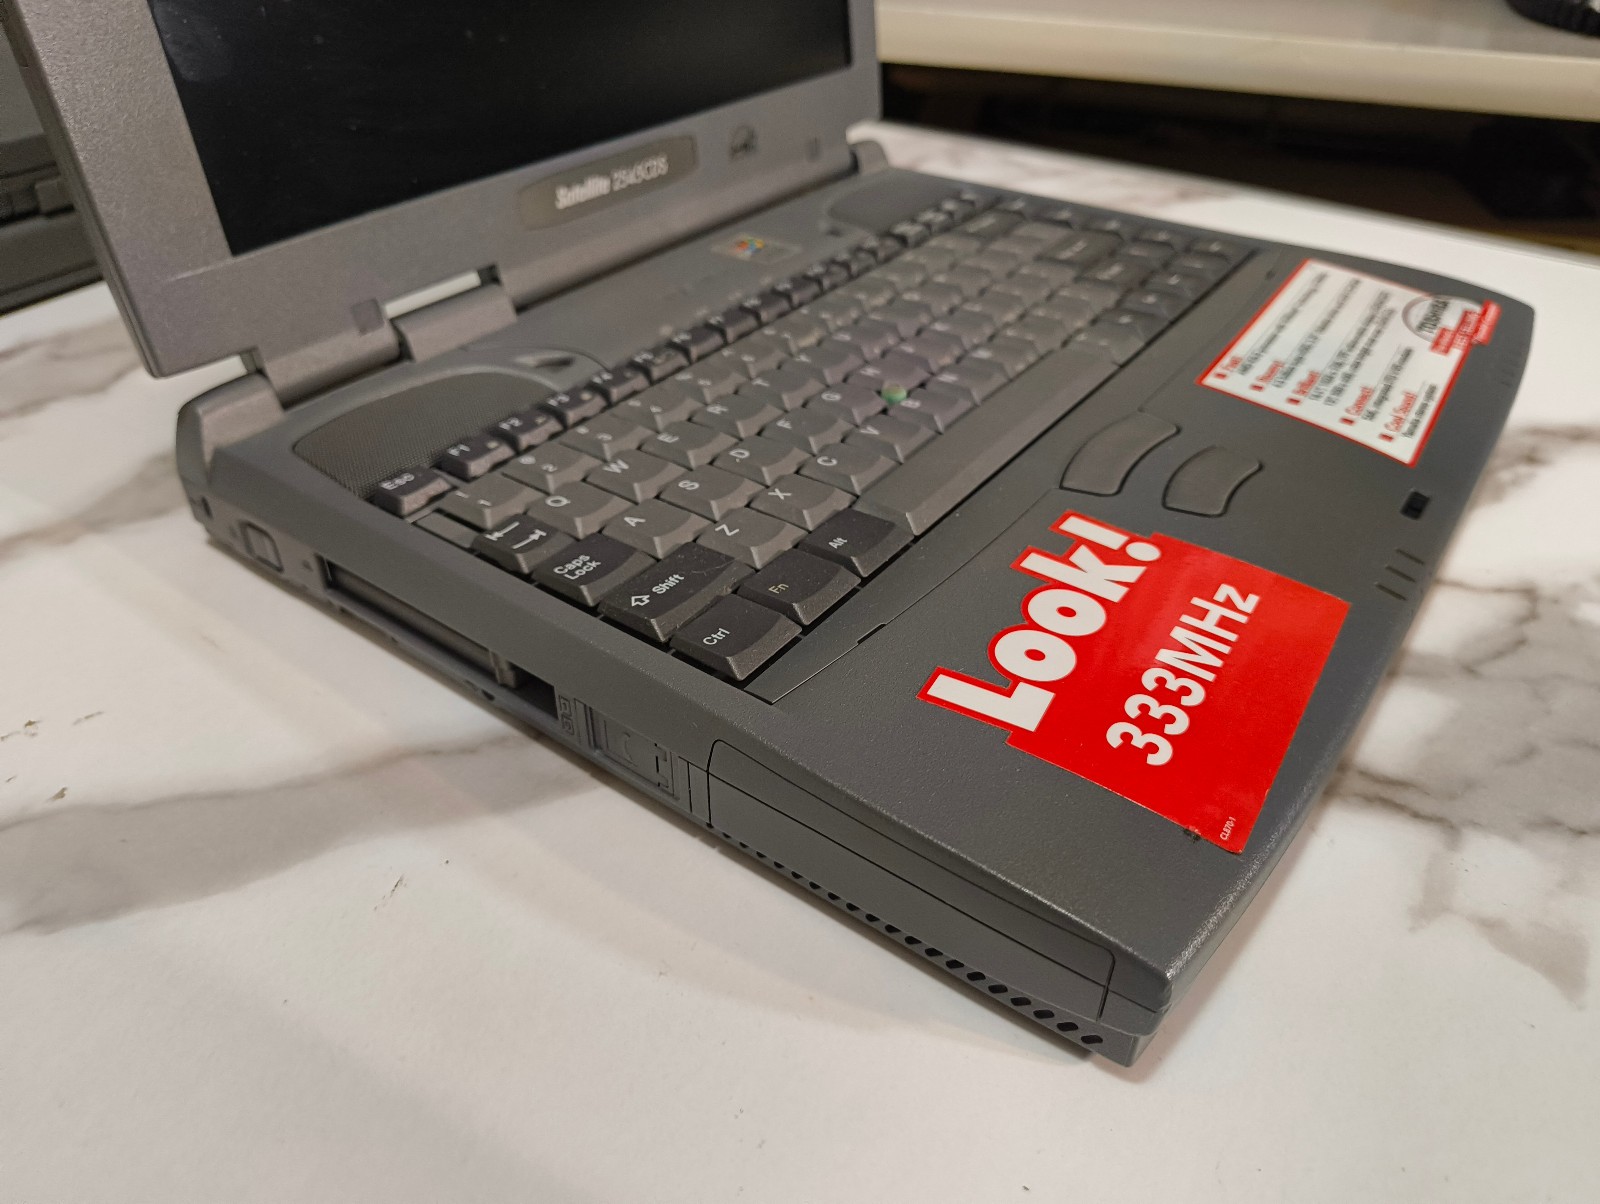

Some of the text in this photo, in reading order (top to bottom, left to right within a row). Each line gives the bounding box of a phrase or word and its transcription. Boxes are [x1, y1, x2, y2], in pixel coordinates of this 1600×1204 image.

[657, 432, 680, 444] E
[728, 448, 750, 460] D
[816, 455, 838, 467] C
[602, 459, 630, 475] W
[381, 472, 415, 491] Esc
[678, 479, 700, 491] S
[545, 494, 571, 508] Q
[767, 487, 793, 501] X
[623, 515, 647, 527] A
[714, 523, 740, 538] Z
[828, 536, 848, 550] Alt
[553, 553, 591, 575] Caps
[564, 560, 602, 580] Lock
[651, 573, 685, 596] Shift
[768, 582, 789, 595] Fn
[926, 514, 1162, 733] Look!
[702, 627, 731, 647] Ctrl
[1105, 582, 1261, 767] 333MHz
